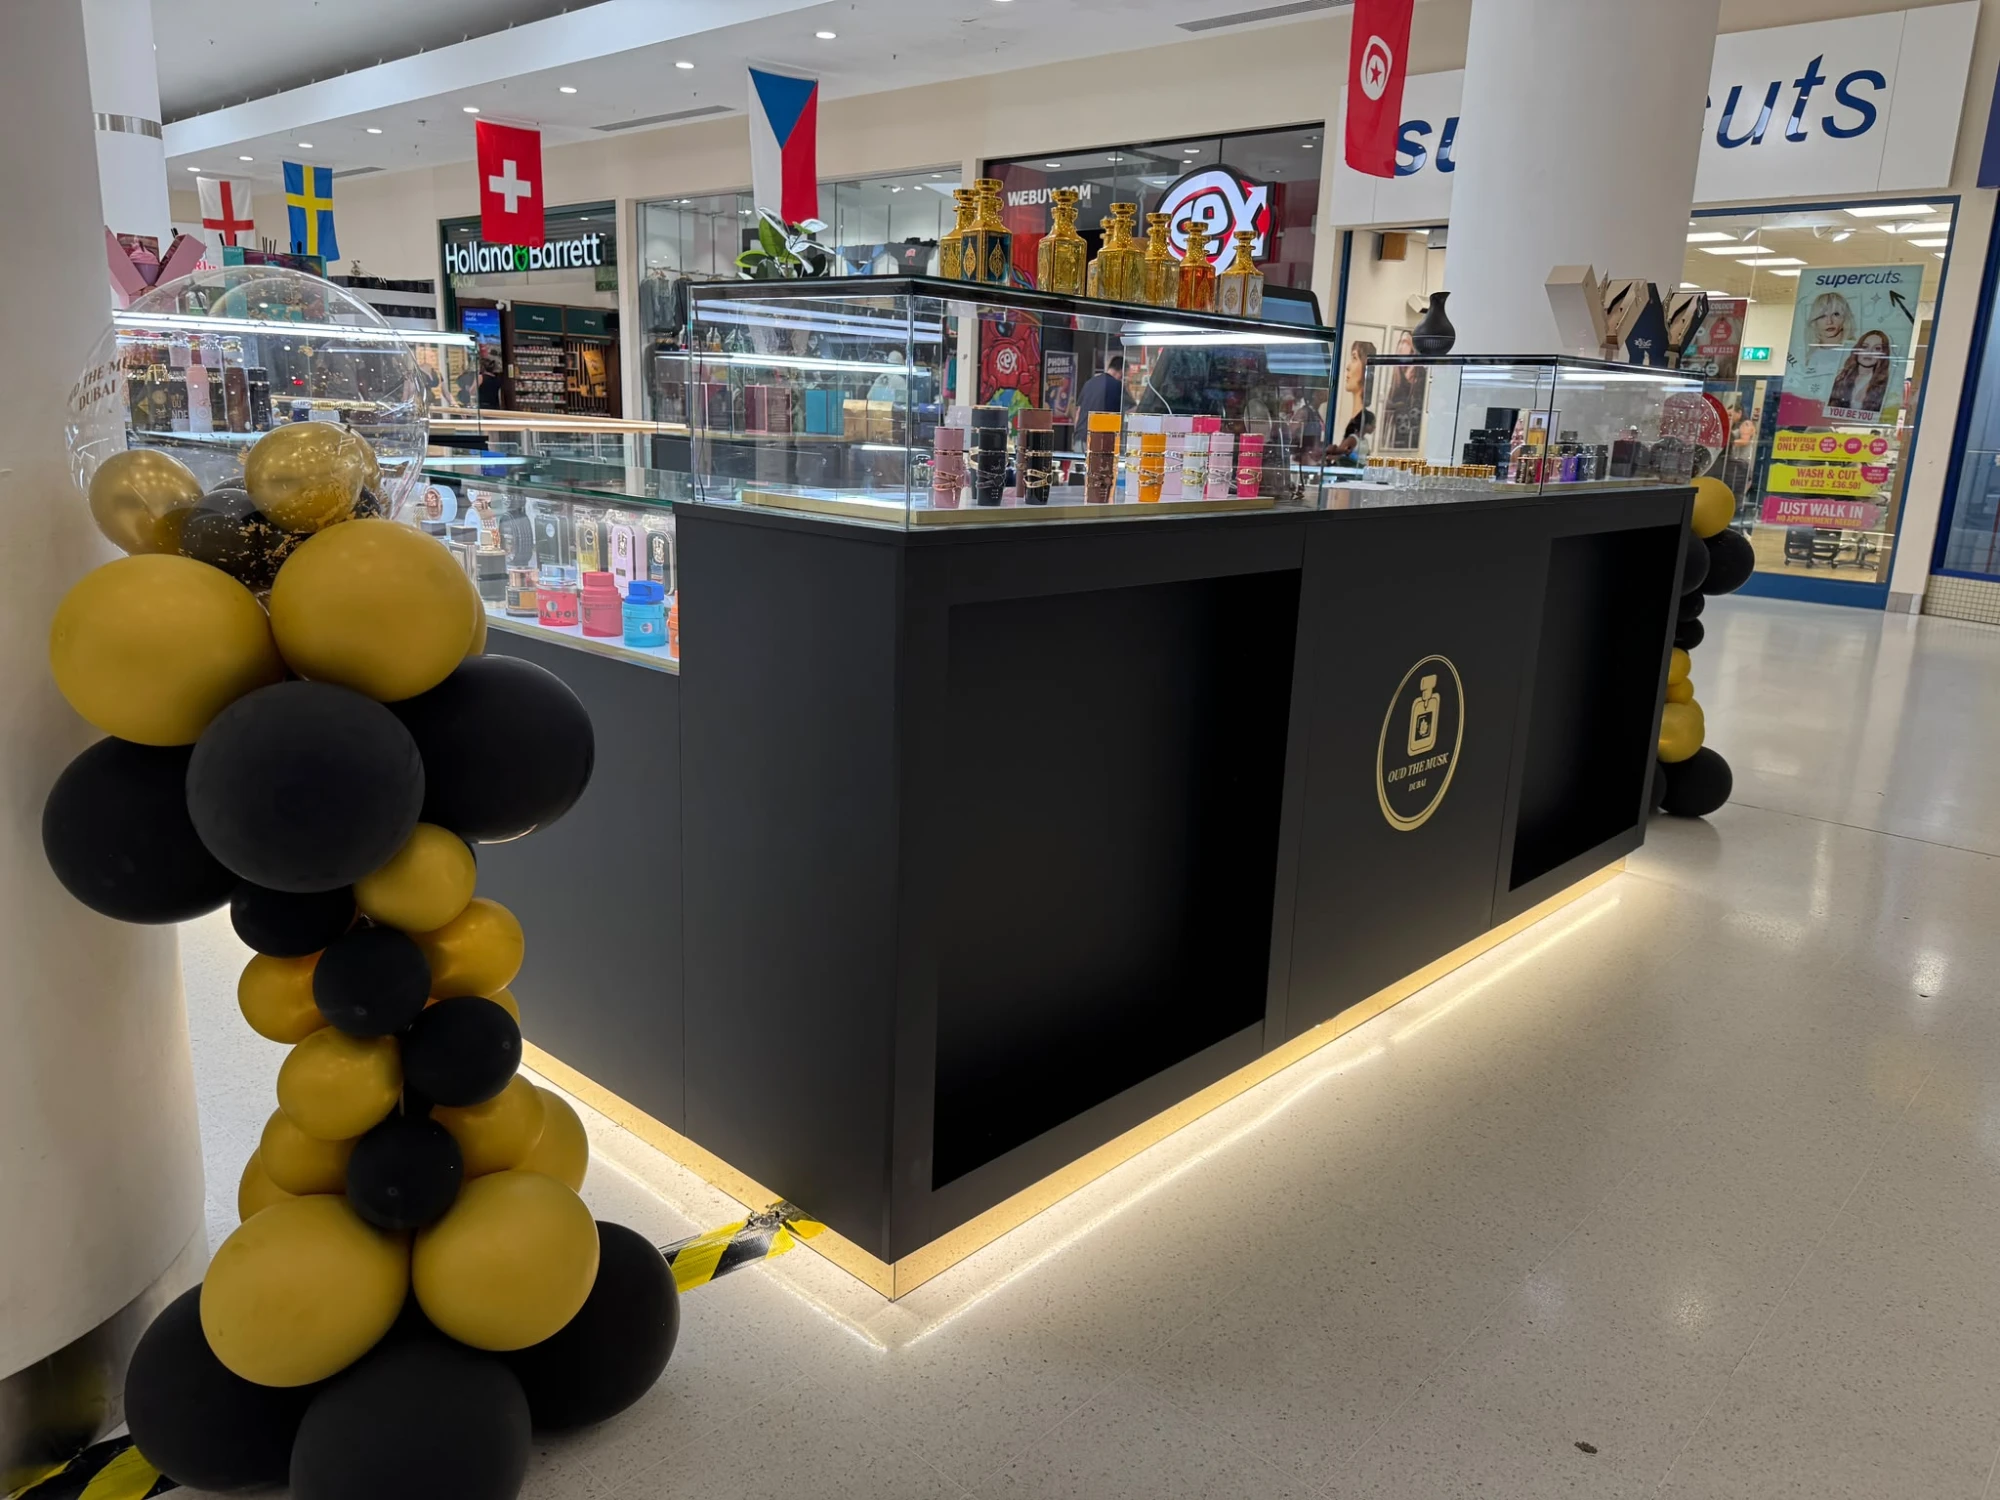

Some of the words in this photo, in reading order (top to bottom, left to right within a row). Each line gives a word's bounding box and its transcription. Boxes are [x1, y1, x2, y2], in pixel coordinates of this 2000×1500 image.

[445, 241, 513, 274] Holland
[529, 233, 601, 270] Barrett
[79, 379, 117, 412] DUBAI
[1829, 407, 1844, 415] YOU
[1846, 410, 1857, 418] BE
[1857, 412, 1874, 421] YOU
[1777, 442, 1797, 451] ONLY
[1797, 468, 1824, 478] WASH
[1827, 470, 1835, 479] &
[1838, 470, 1858, 480] CUT
[1790, 478, 1808, 487] ONLY
[1810, 479, 1825, 488] £32
[1777, 501, 1808, 515] JUST
[1810, 503, 1845, 518] WALK
[1849, 505, 1864, 519] IN
[1388, 767, 1407, 783] OUD
[1408, 761, 1426, 776] THE
[1425, 752, 1449, 771] MUSK
[1408, 778, 1427, 792] DUBAI
